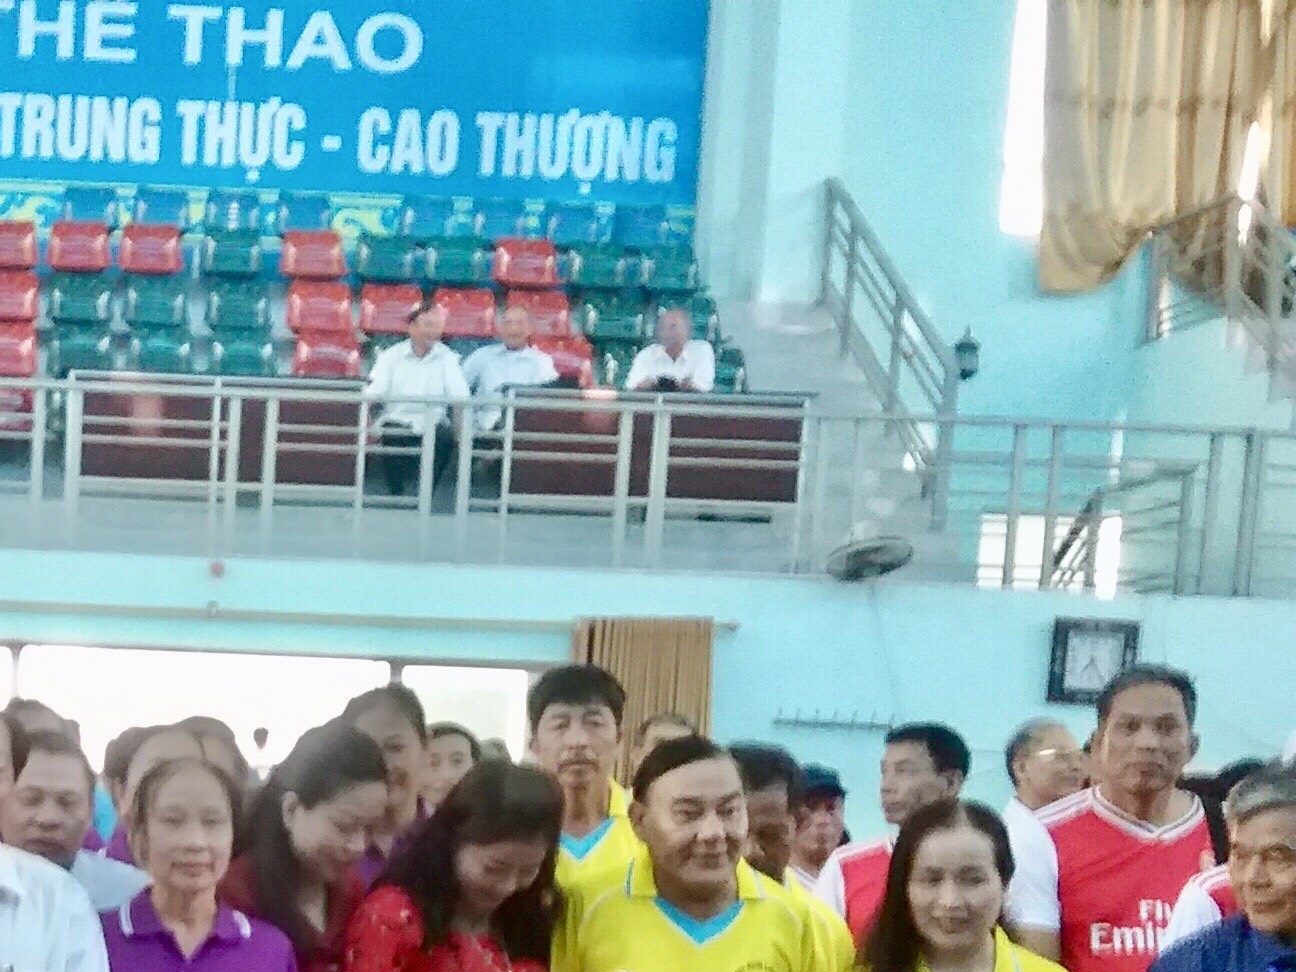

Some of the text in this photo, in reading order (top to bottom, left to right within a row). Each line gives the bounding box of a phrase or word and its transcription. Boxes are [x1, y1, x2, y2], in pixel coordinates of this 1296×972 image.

[167, 4, 425, 75] THAO
[176, 97, 306, 182] THỰC
[357, 106, 461, 177] CAO
[476, 107, 678, 195] THƯỢNG
